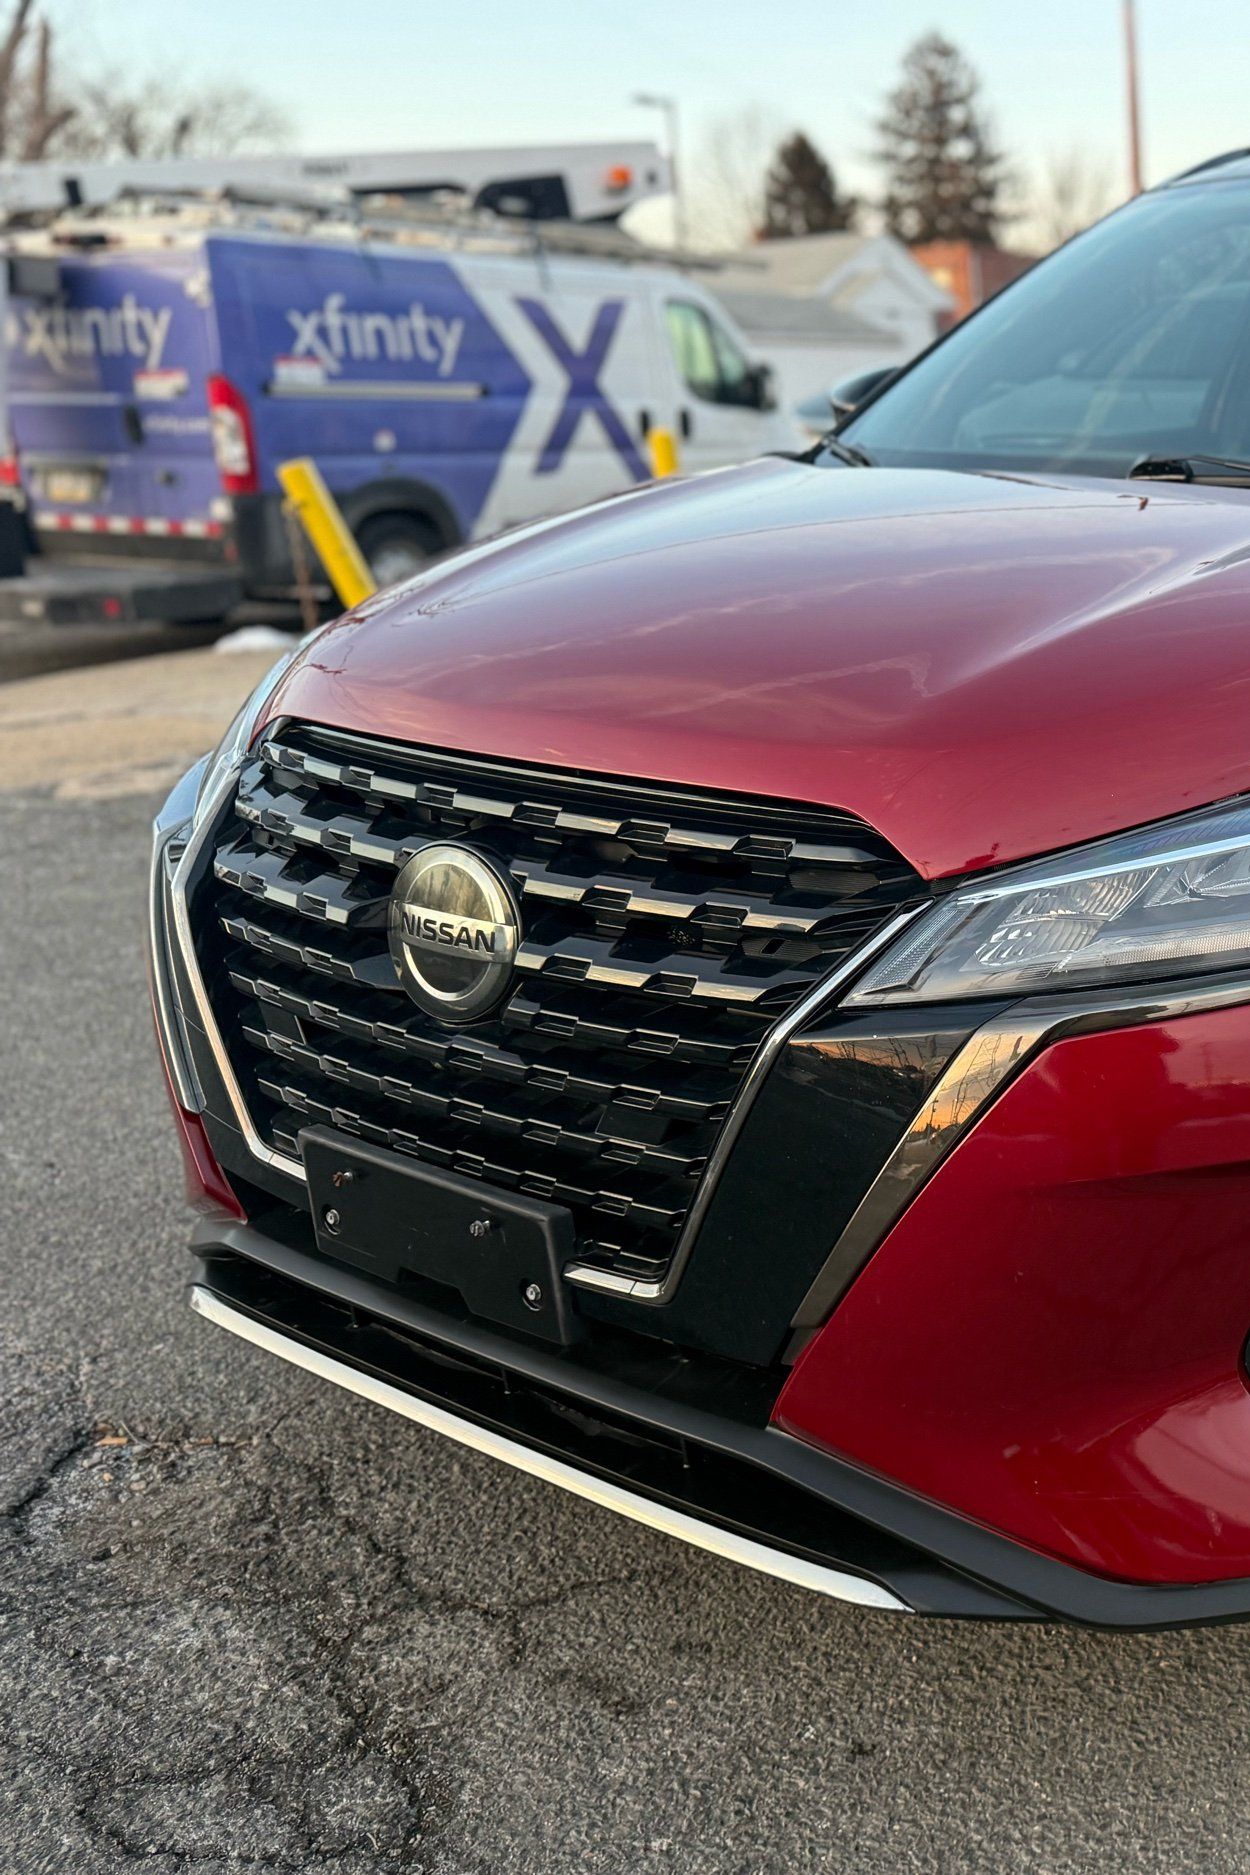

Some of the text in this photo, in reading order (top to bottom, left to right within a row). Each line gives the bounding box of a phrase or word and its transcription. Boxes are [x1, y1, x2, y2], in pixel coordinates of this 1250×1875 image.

[287, 293, 465, 377] xfinity
[513, 296, 656, 484] X
[402, 912, 495, 953] NISSAN
